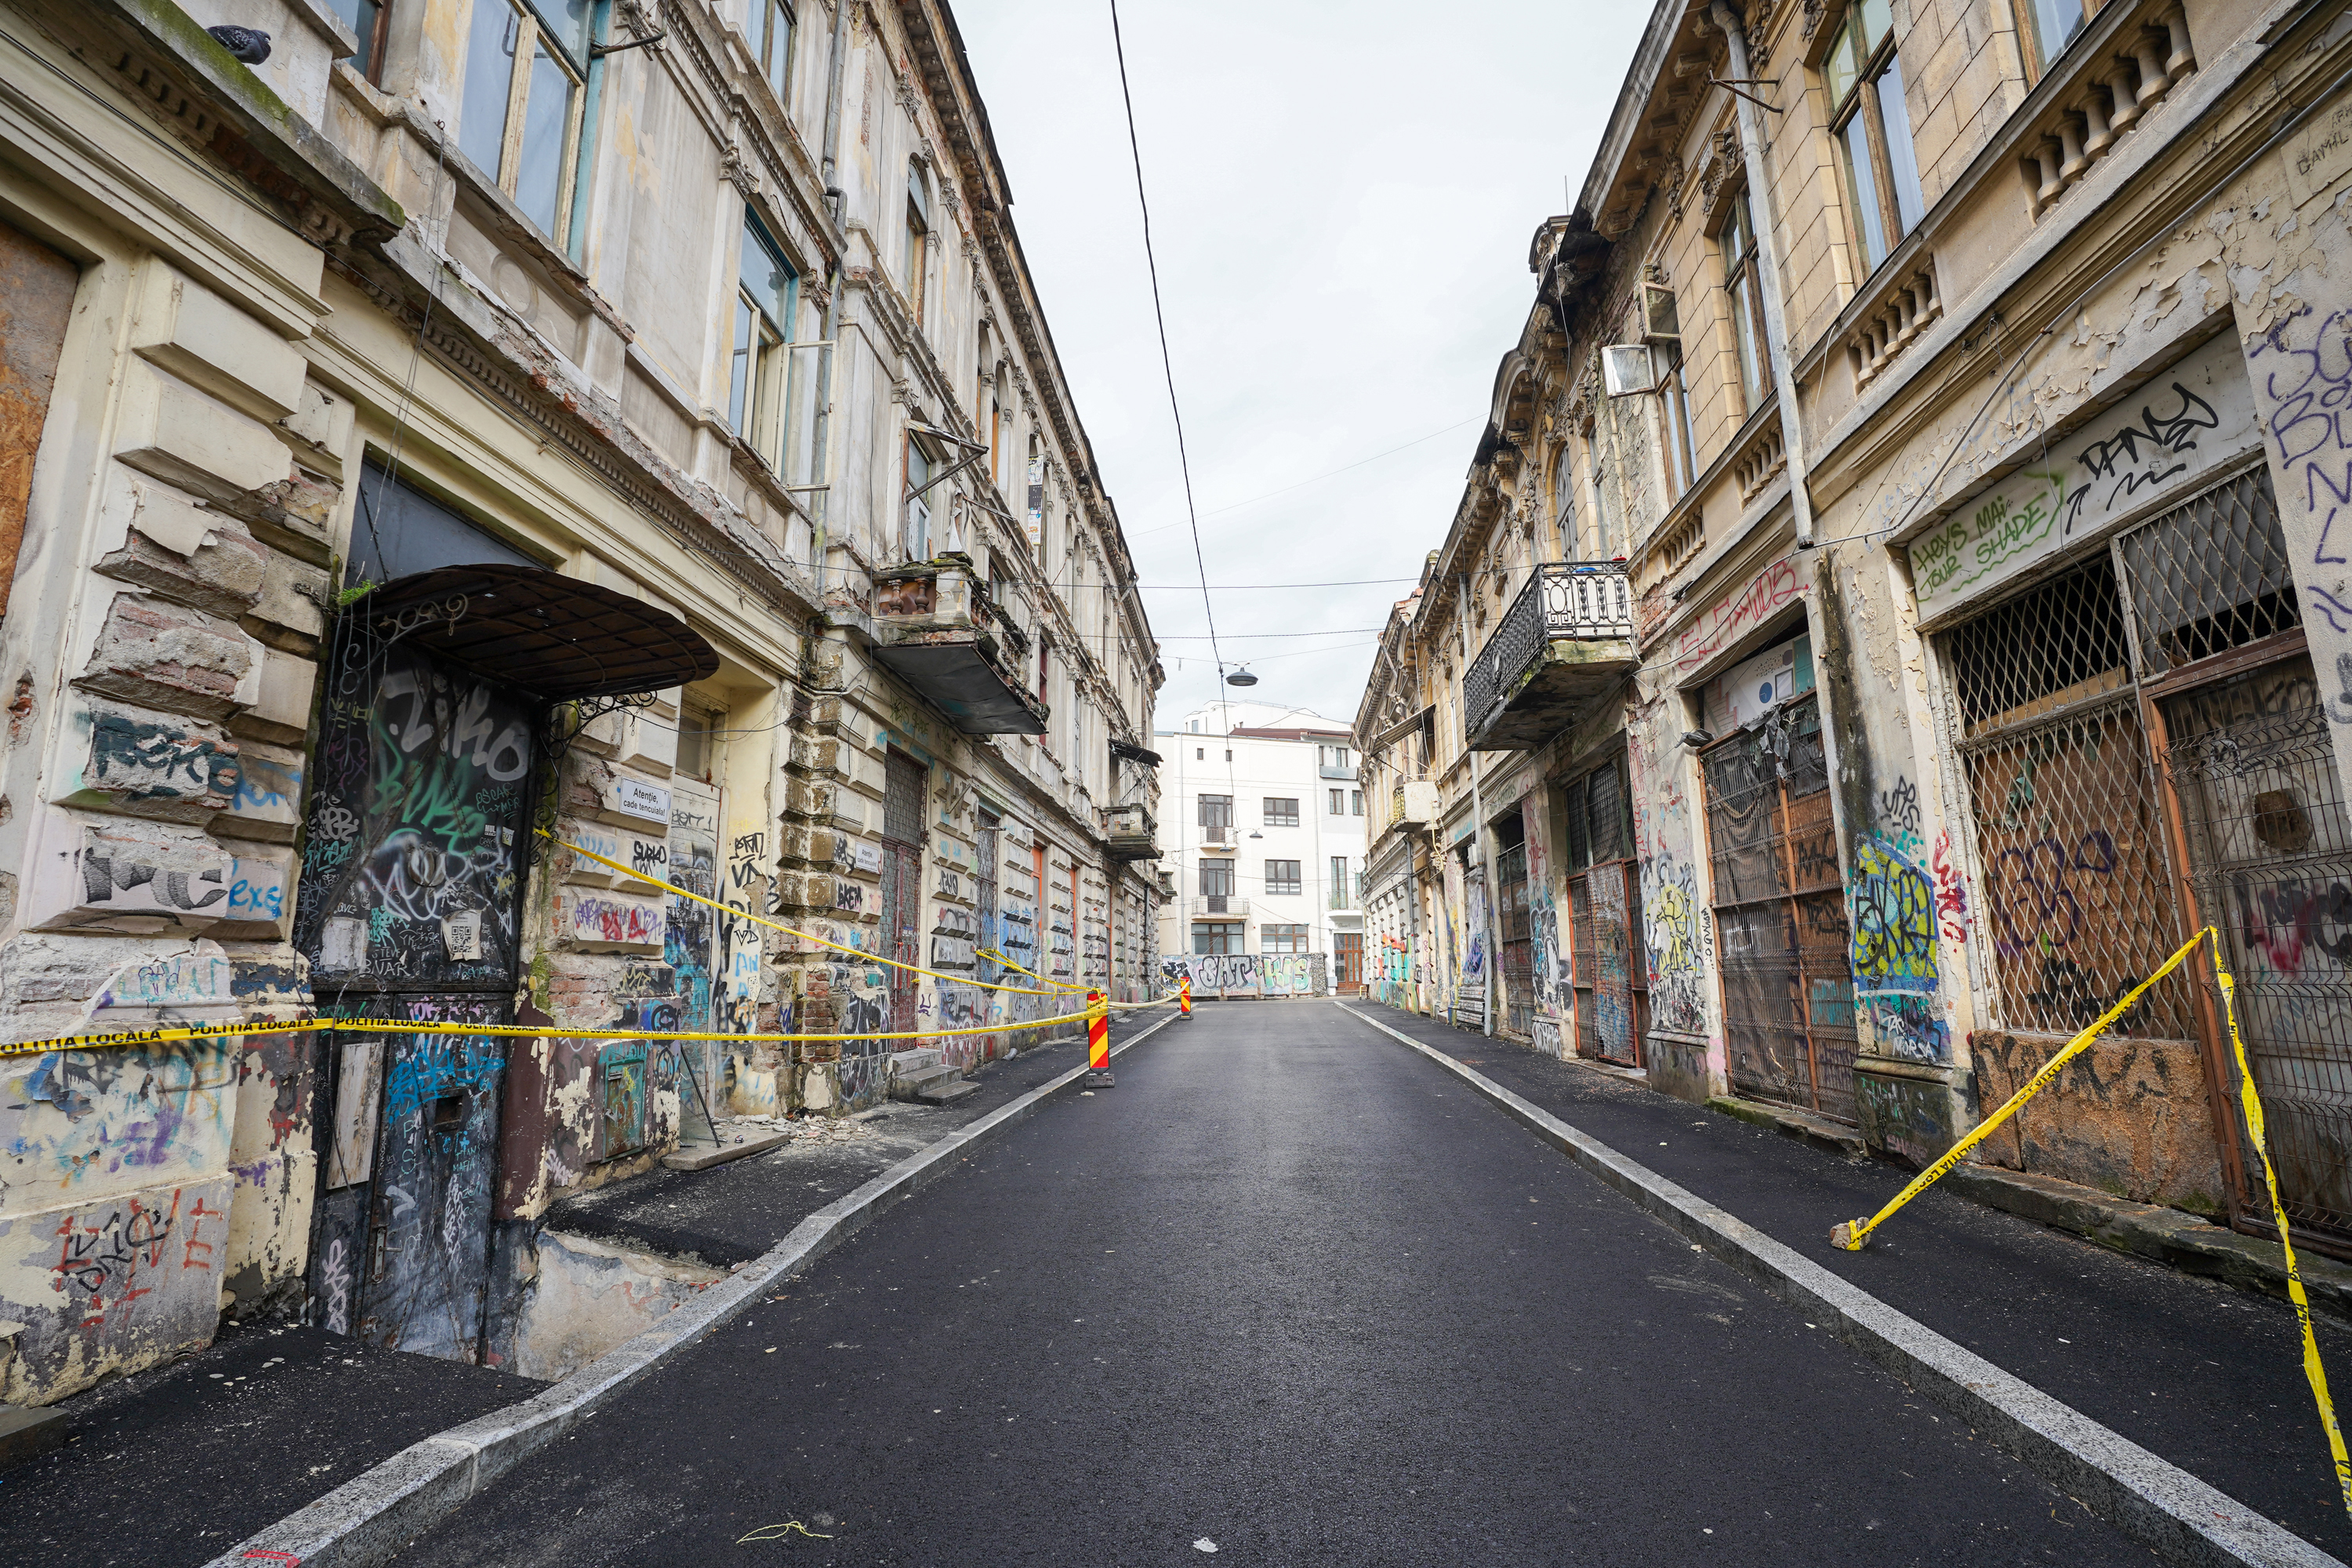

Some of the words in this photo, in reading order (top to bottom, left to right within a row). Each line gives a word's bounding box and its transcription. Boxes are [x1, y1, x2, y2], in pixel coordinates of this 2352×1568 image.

[1976, 491, 2049, 564] SHADE
[623, 800, 638, 811] cade
[638, 804, 666, 818] tencuiala!
[0, 1036, 79, 1055] OLITIA
[84, 1029, 162, 1047] LOCALA
[258, 1019, 314, 1031] LOCALA
